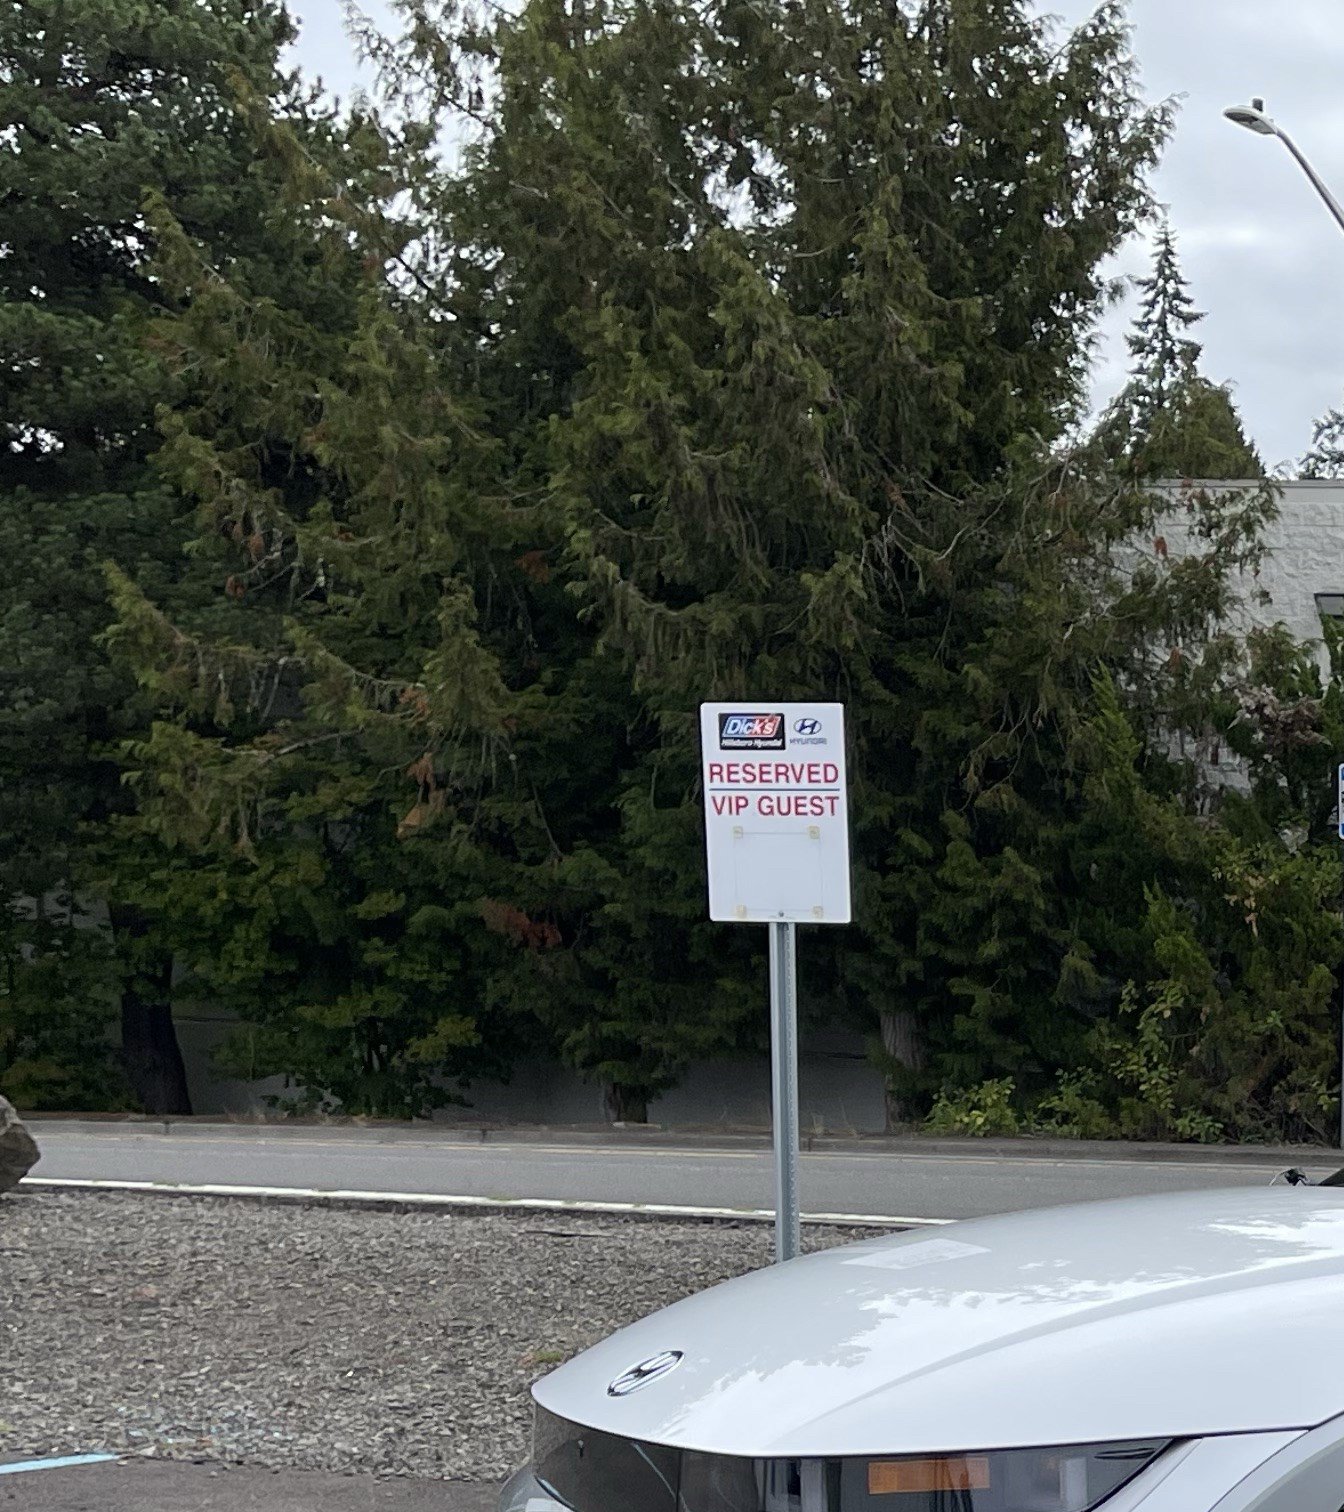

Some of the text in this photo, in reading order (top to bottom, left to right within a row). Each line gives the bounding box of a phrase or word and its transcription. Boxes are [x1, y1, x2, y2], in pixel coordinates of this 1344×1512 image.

[709, 763, 839, 784] RESERVED
[712, 796, 840, 816] VIP GUEST
